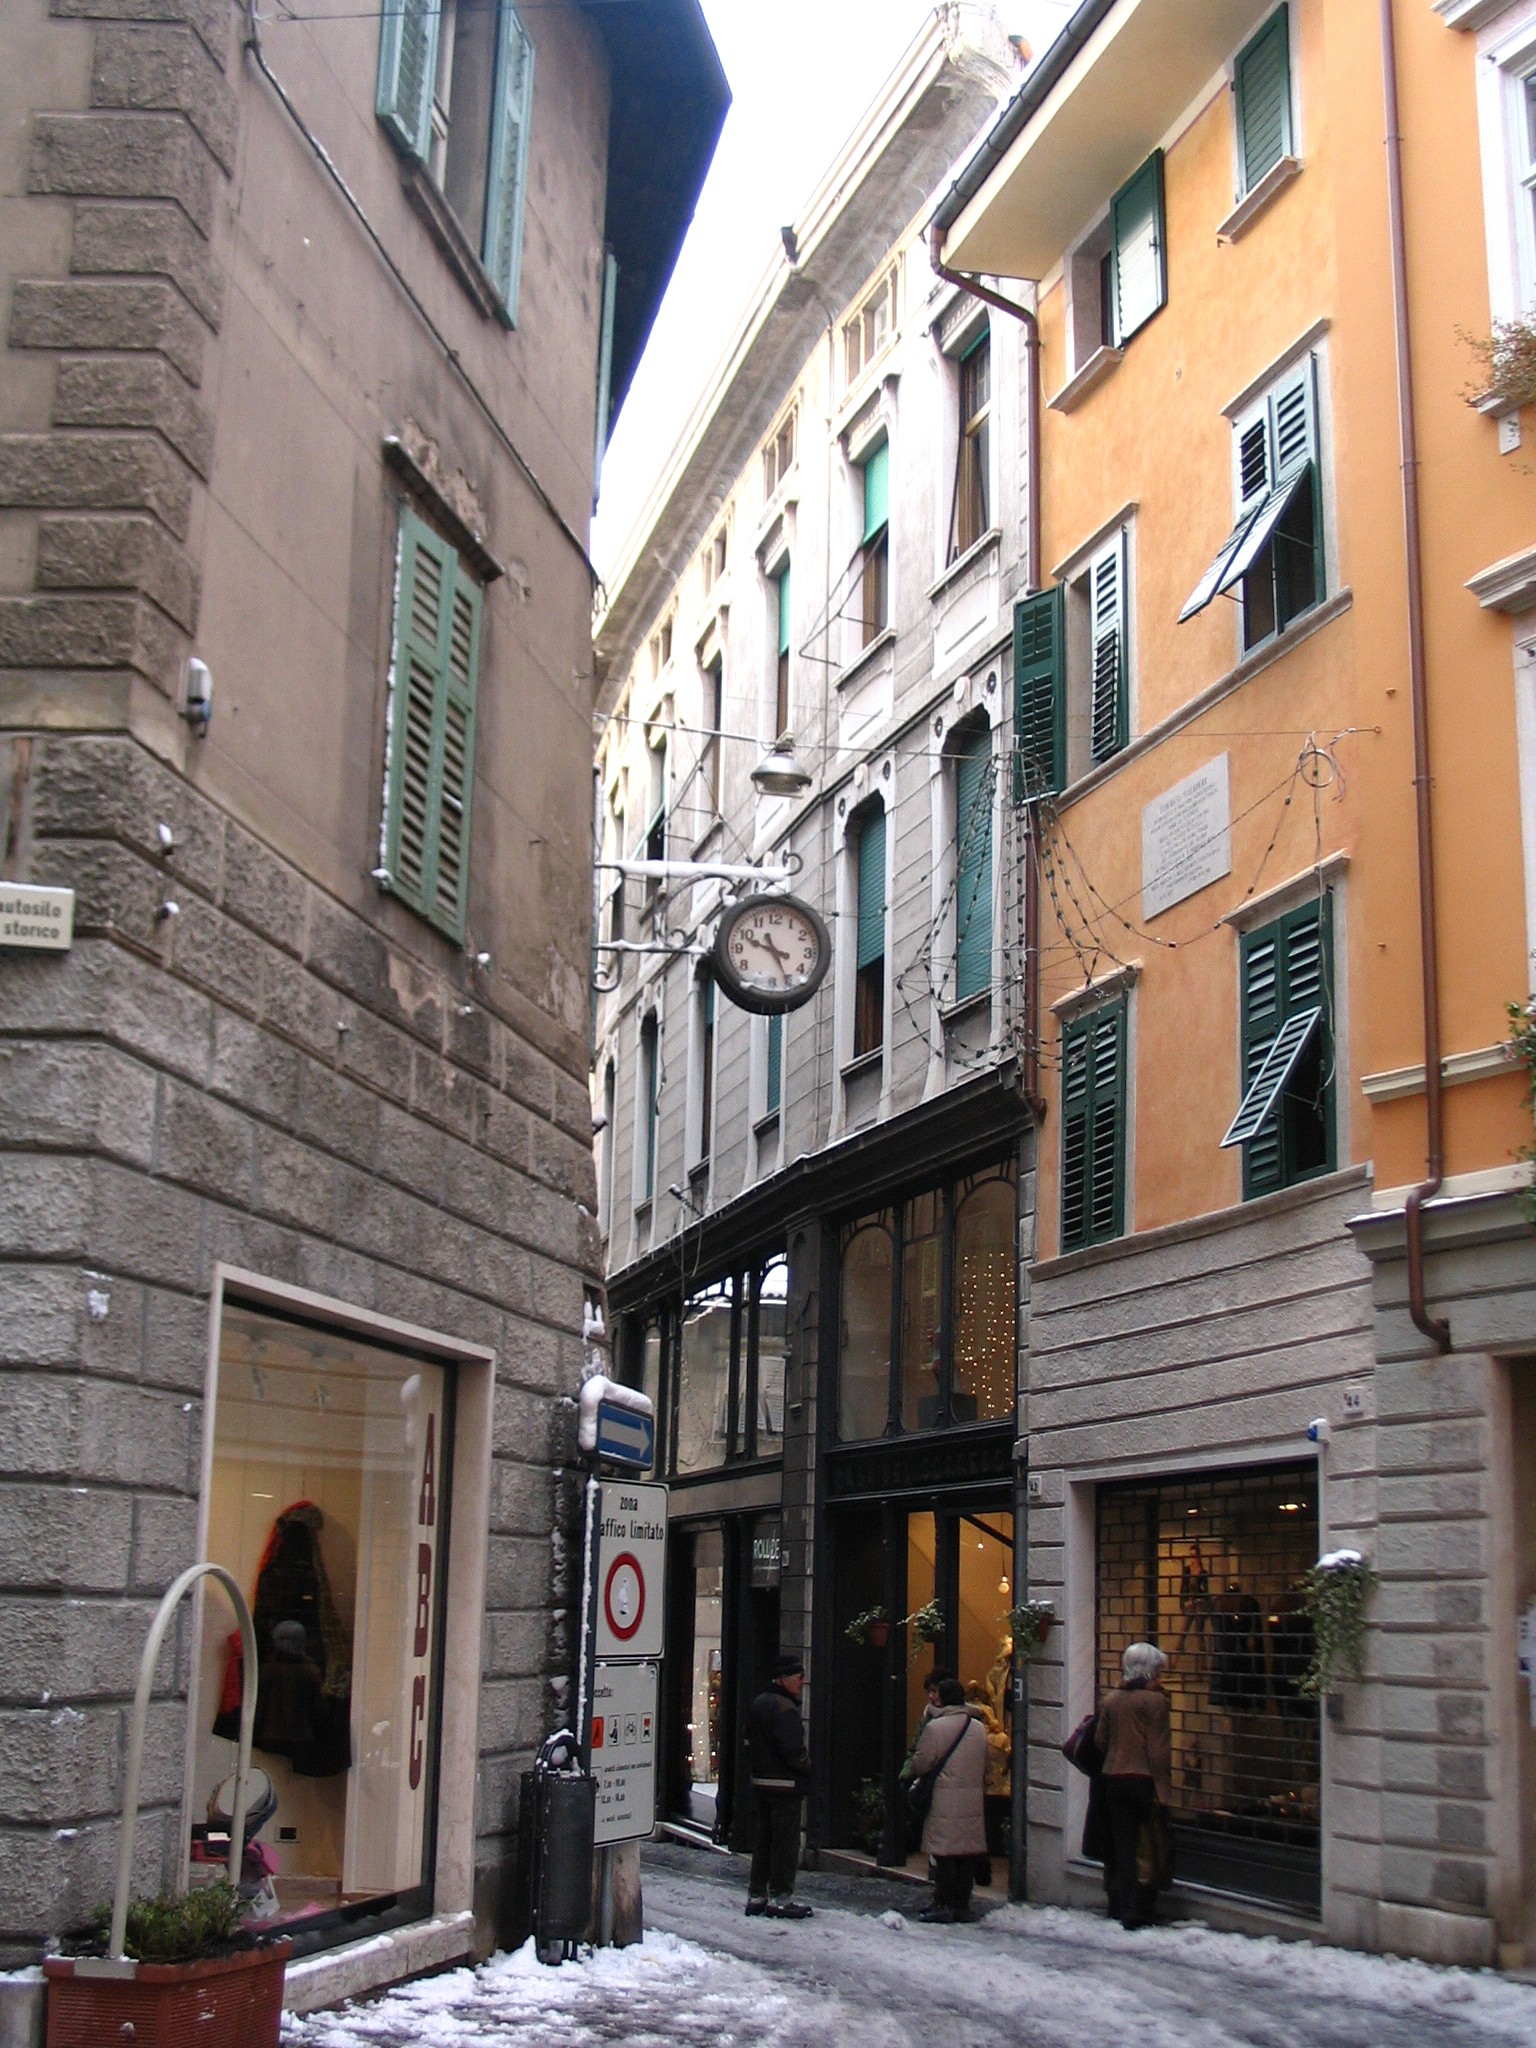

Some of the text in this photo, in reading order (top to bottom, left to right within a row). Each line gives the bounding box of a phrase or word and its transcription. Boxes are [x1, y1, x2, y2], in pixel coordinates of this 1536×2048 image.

[754, 916, 764, 928] 11
[769, 914, 783, 925] 12
[788, 919, 794, 930] 1
[4, 921, 60, 939] storico
[740, 929, 754, 940] 10
[799, 930, 807, 941] 2
[735, 943, 743, 954] 9
[804, 948, 812, 959] 3
[740, 960, 748, 971] 8
[796, 963, 805, 974] 4
[620, 1497, 638, 1511] zona
[631, 1520, 664, 1540] limitato
[409, 1413, 435, 1790] ABC
